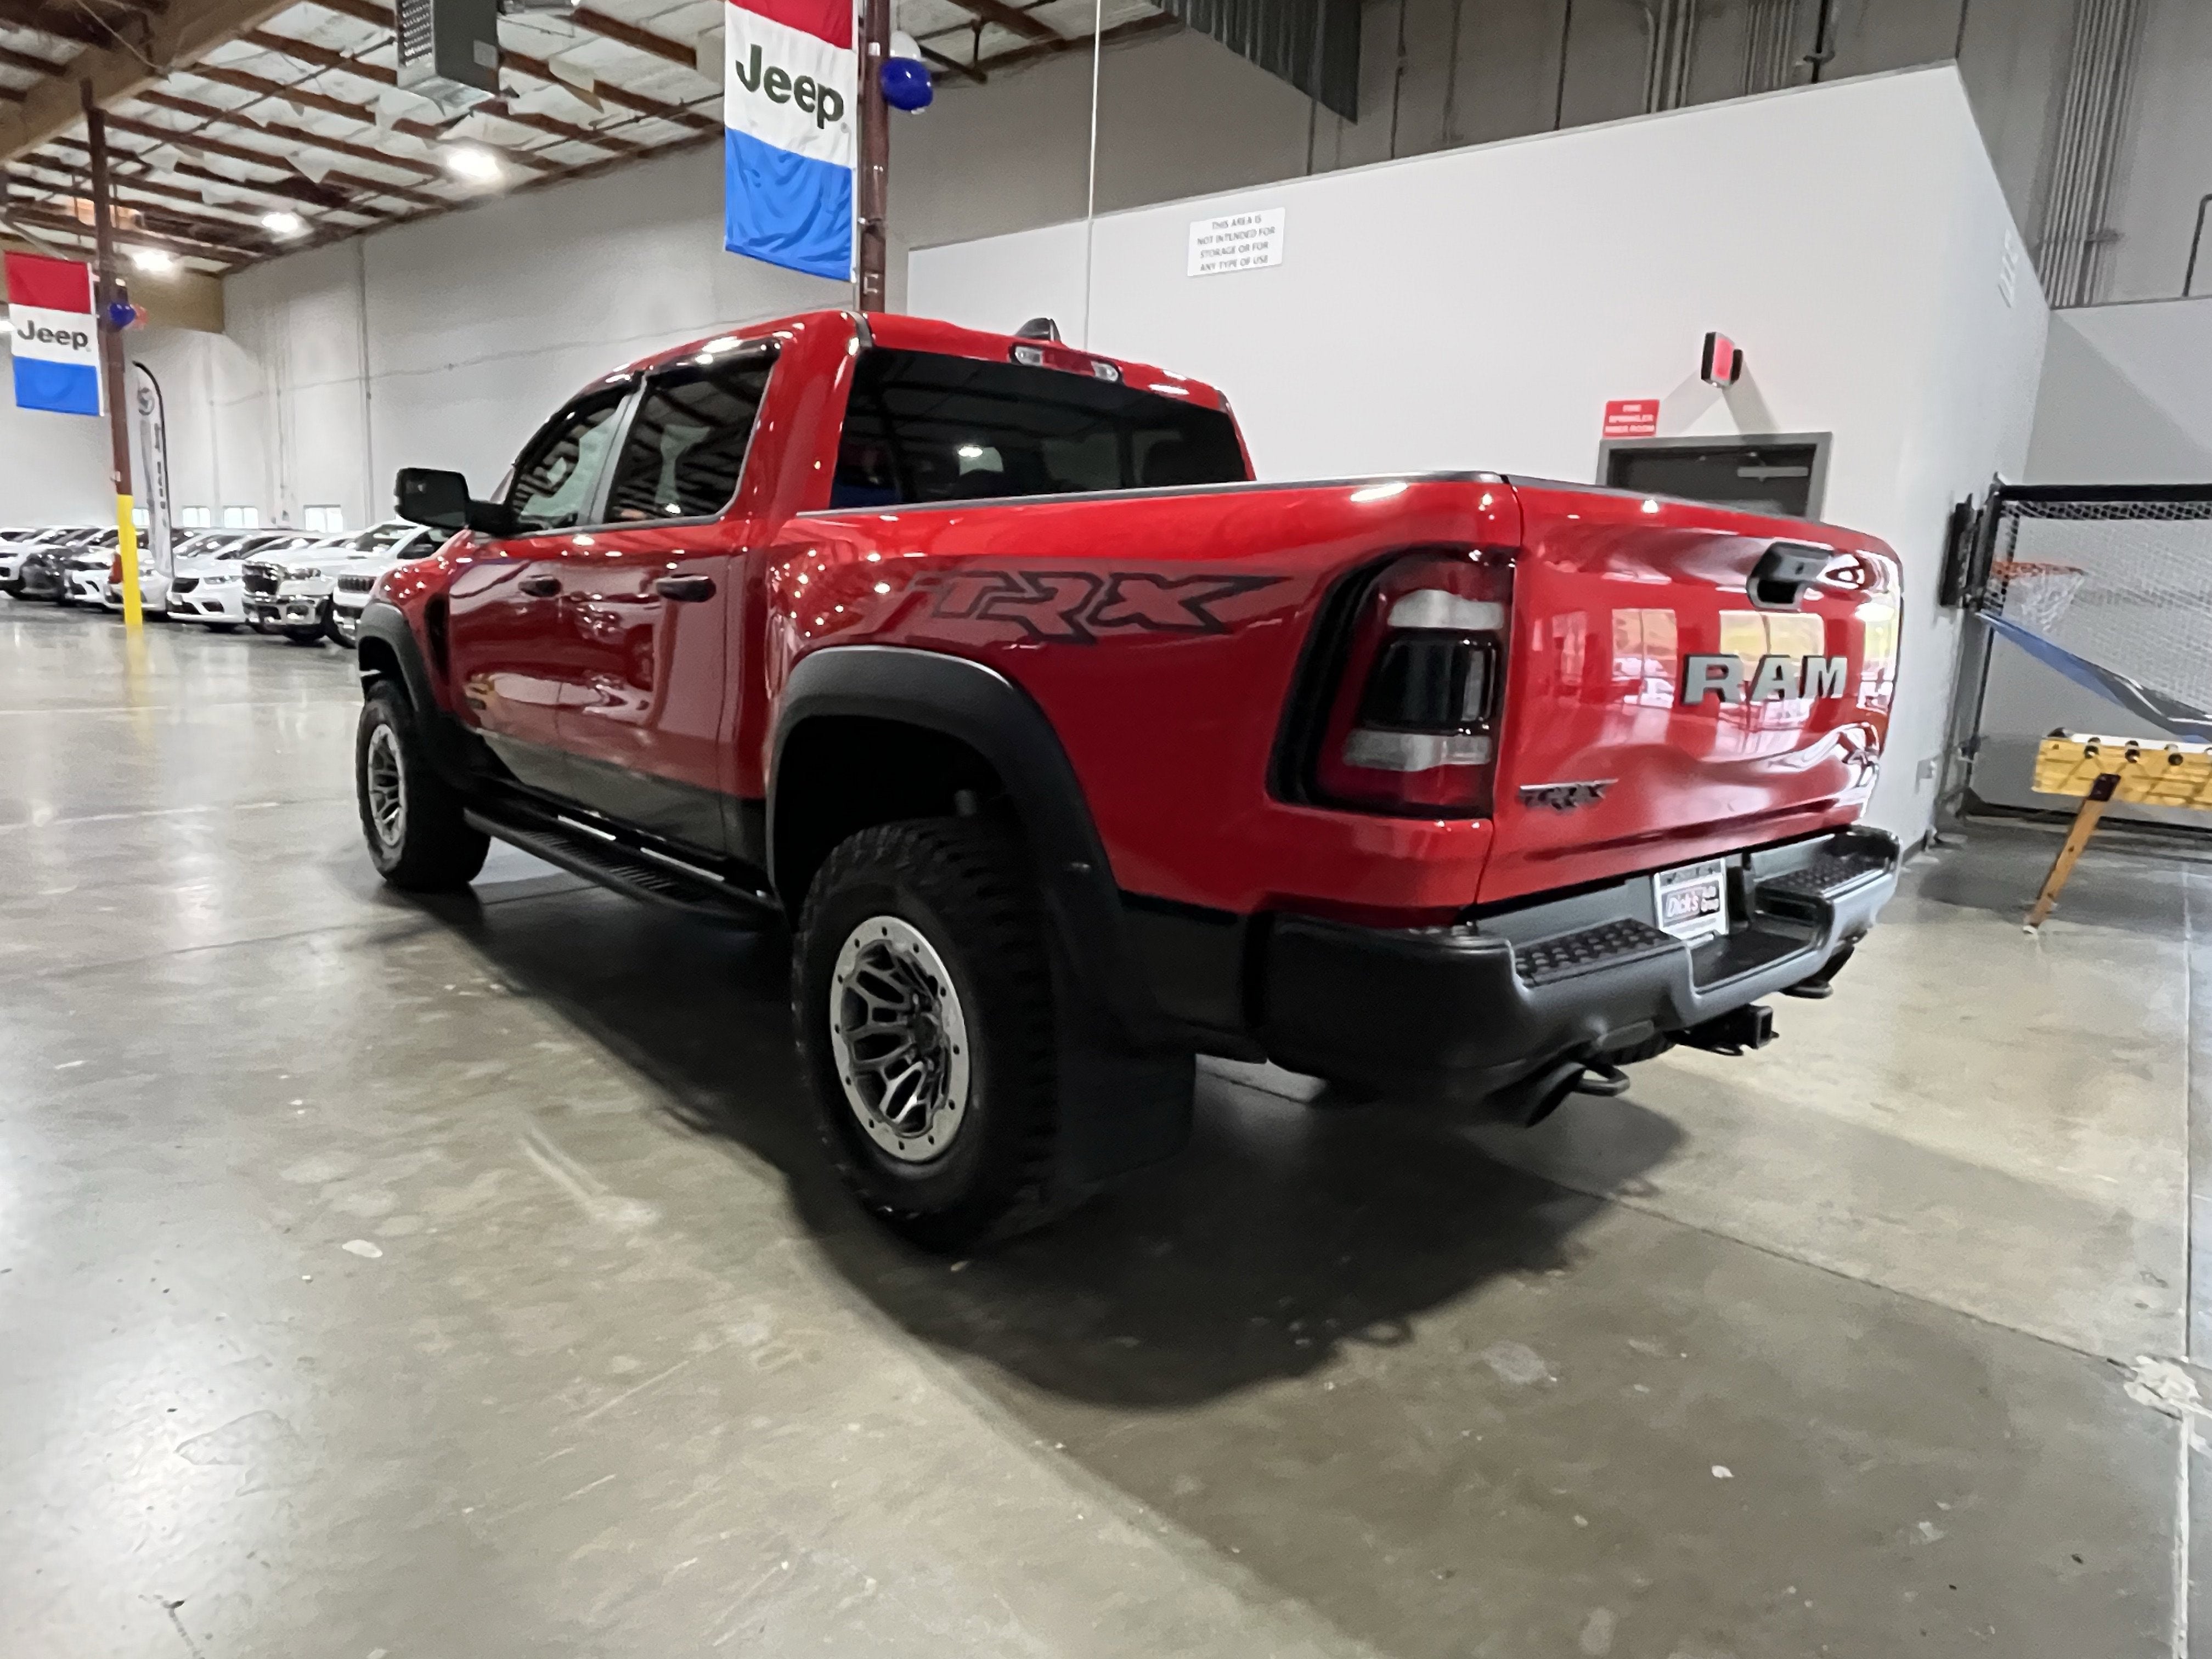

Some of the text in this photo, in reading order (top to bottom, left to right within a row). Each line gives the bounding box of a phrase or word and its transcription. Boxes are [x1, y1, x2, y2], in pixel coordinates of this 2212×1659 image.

[735, 44, 844, 129] Jeep
[1212, 215, 1262, 229] THIS AREA IS
[1197, 227, 1276, 245] NOT INTENDED FOR
[1200, 241, 1268, 258] STORAGE OR FOR
[1200, 255, 1268, 271] ANY TYPE OF USE
[18, 320, 88, 351] Jeep
[911, 571, 1295, 645] TRX
[1680, 654, 1848, 706] RAM
